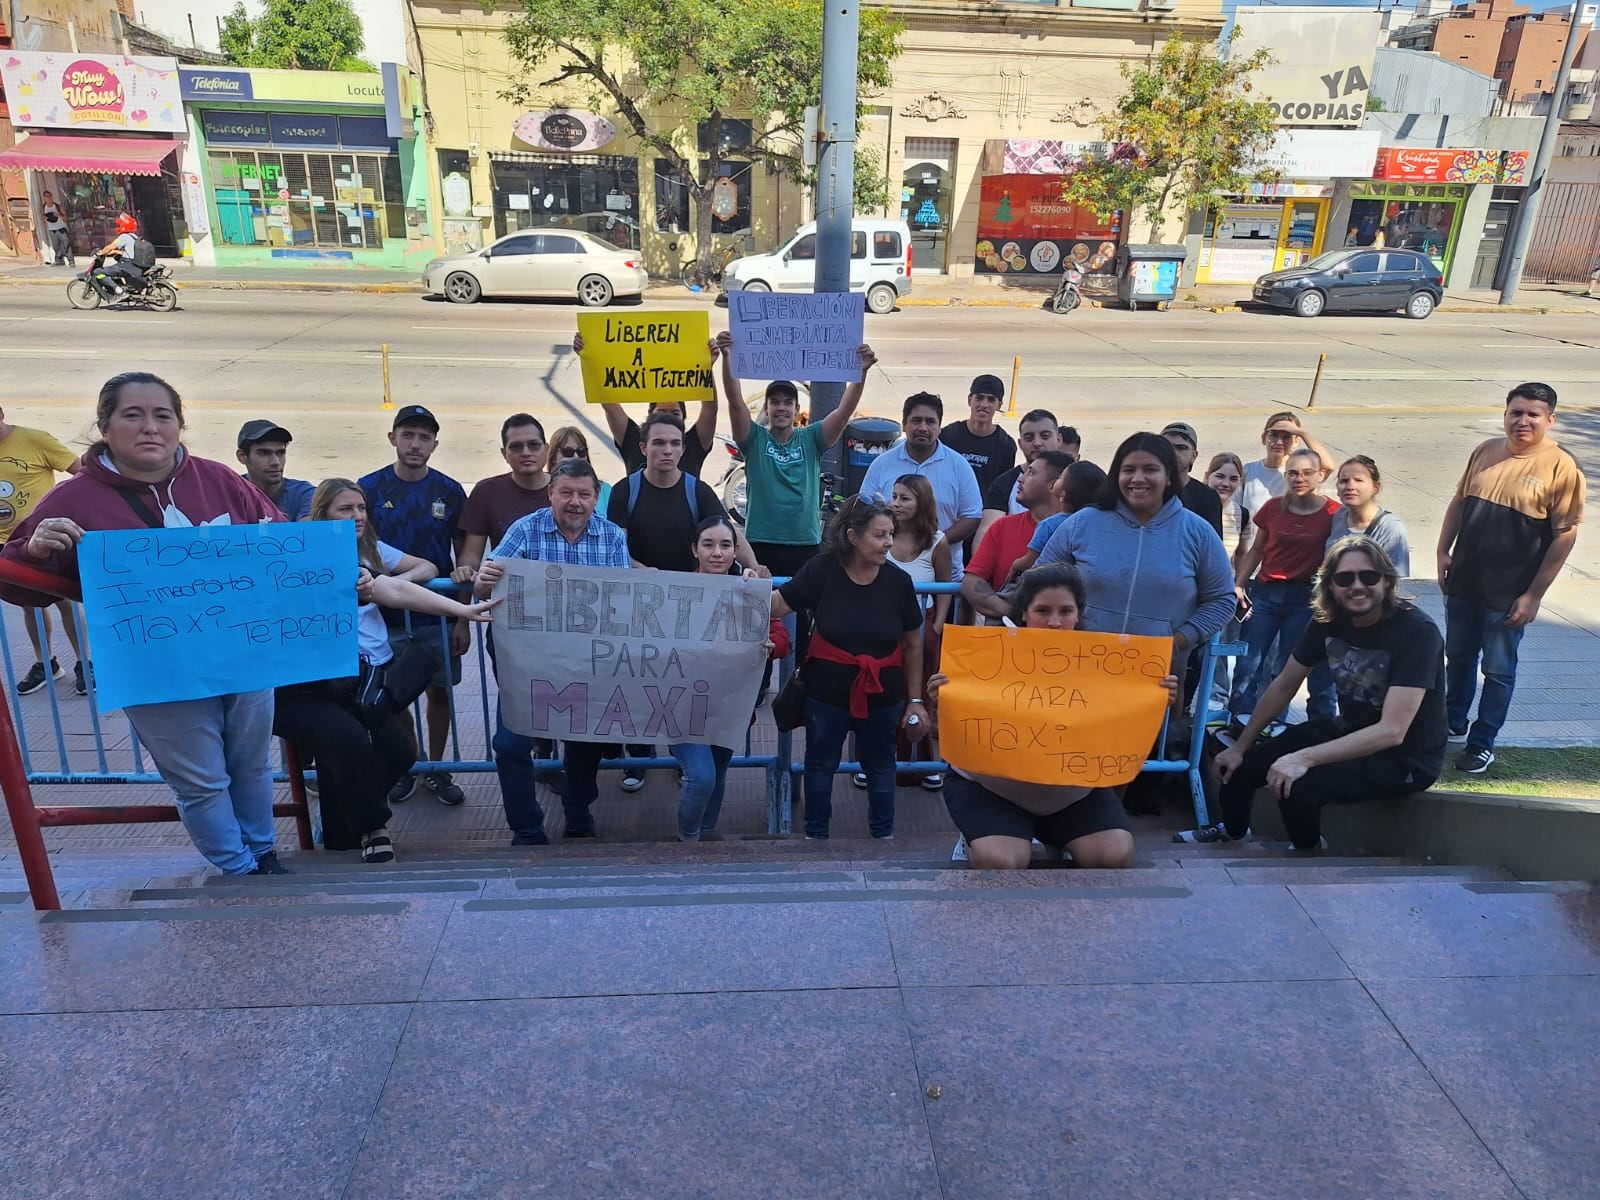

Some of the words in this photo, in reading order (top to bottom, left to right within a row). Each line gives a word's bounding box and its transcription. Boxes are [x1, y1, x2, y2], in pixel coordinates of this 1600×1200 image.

[72, 70, 105, 87] Muy
[1320, 65, 1369, 99] YA
[63, 84, 122, 107] Wow!
[1267, 102, 1363, 121] OCOPIAS
[631, 347, 643, 367] A
[736, 351, 748, 374] A
[591, 639, 686, 679] PARA
[1001, 681, 1089, 711] PARA
